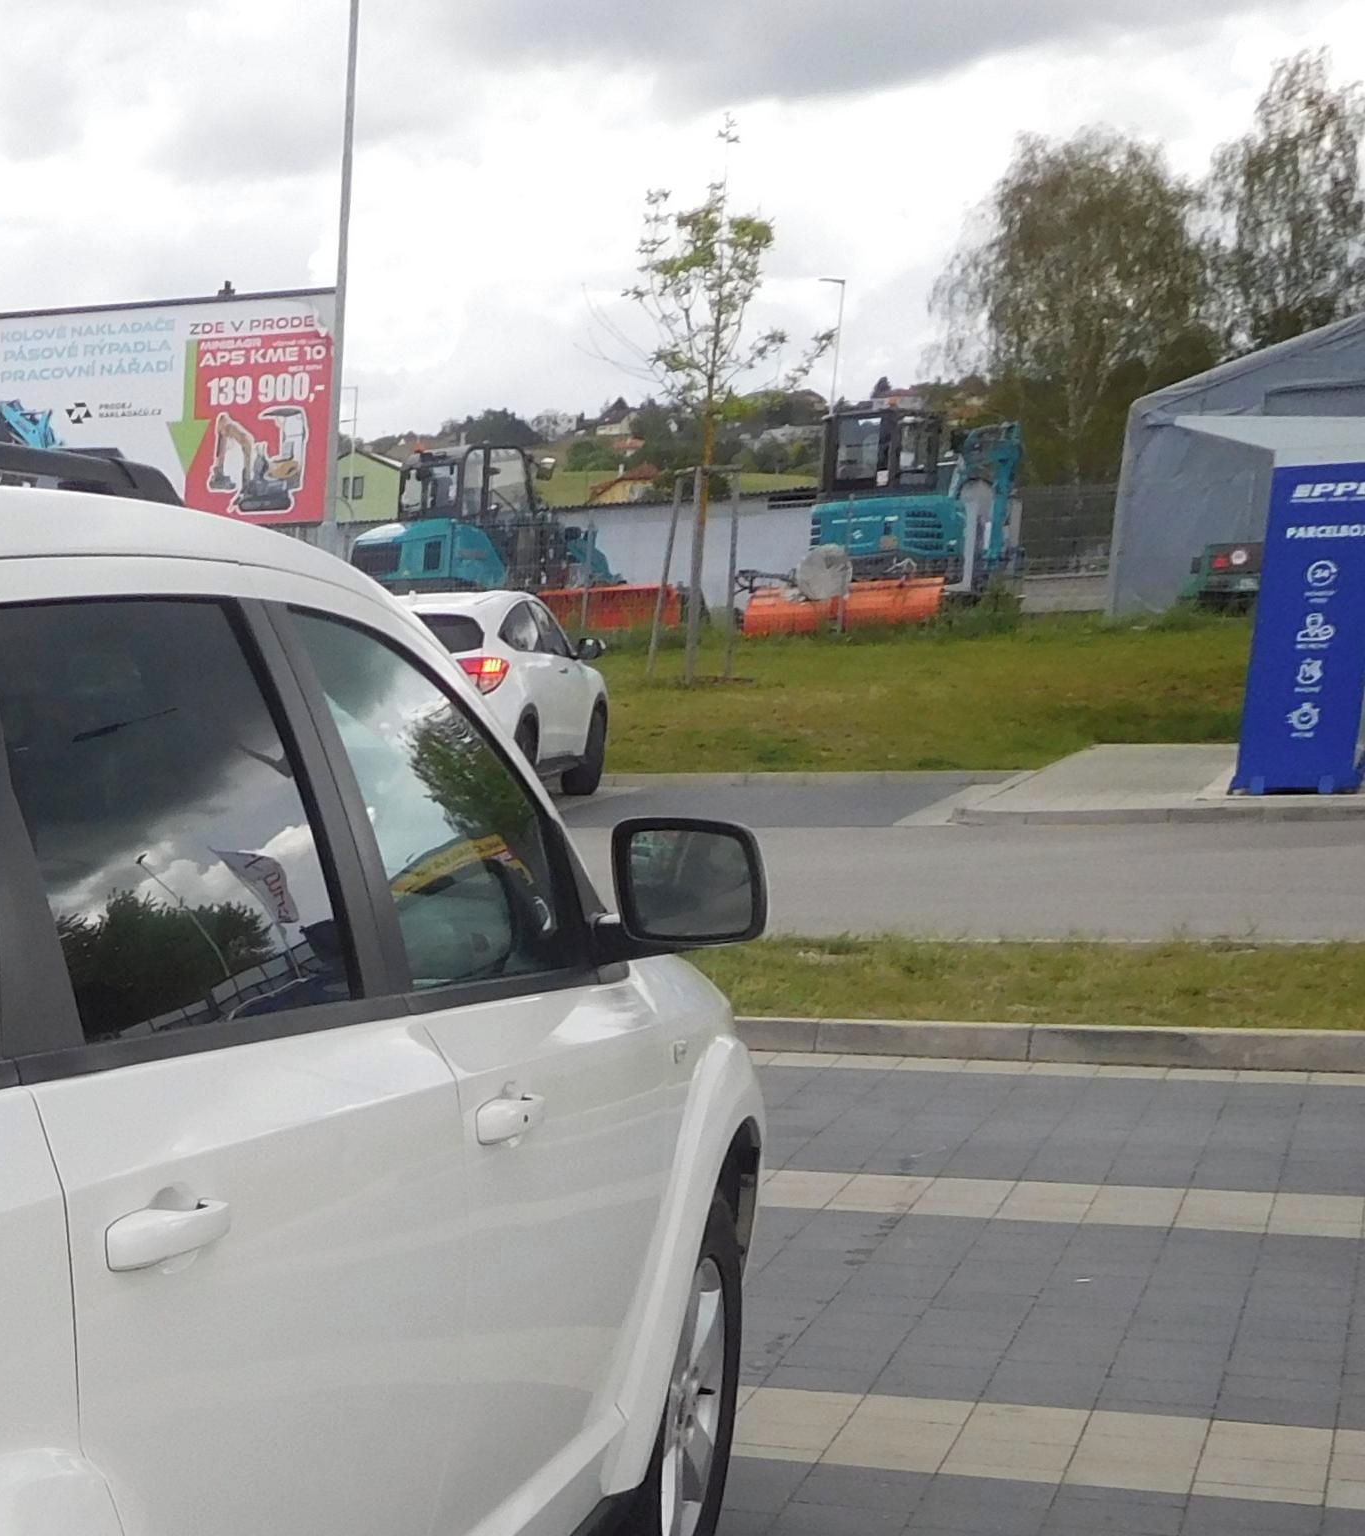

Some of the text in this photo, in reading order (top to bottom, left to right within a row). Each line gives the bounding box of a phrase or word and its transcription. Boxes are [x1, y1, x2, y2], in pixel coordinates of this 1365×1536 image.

[0, 317, 176, 343] KOLOVÉ NAKLADAČE
[190, 315, 315, 335] ZDE V PRODE
[3, 338, 173, 362] PÁSOVÉ RÝPADLA
[199, 350, 246, 367] APS
[250, 347, 299, 364] KME
[304, 345, 326, 361] 10
[0, 354, 175, 383] PRACOVNÍ NÁŘADÍ
[207, 371, 326, 406] 139 900,-
